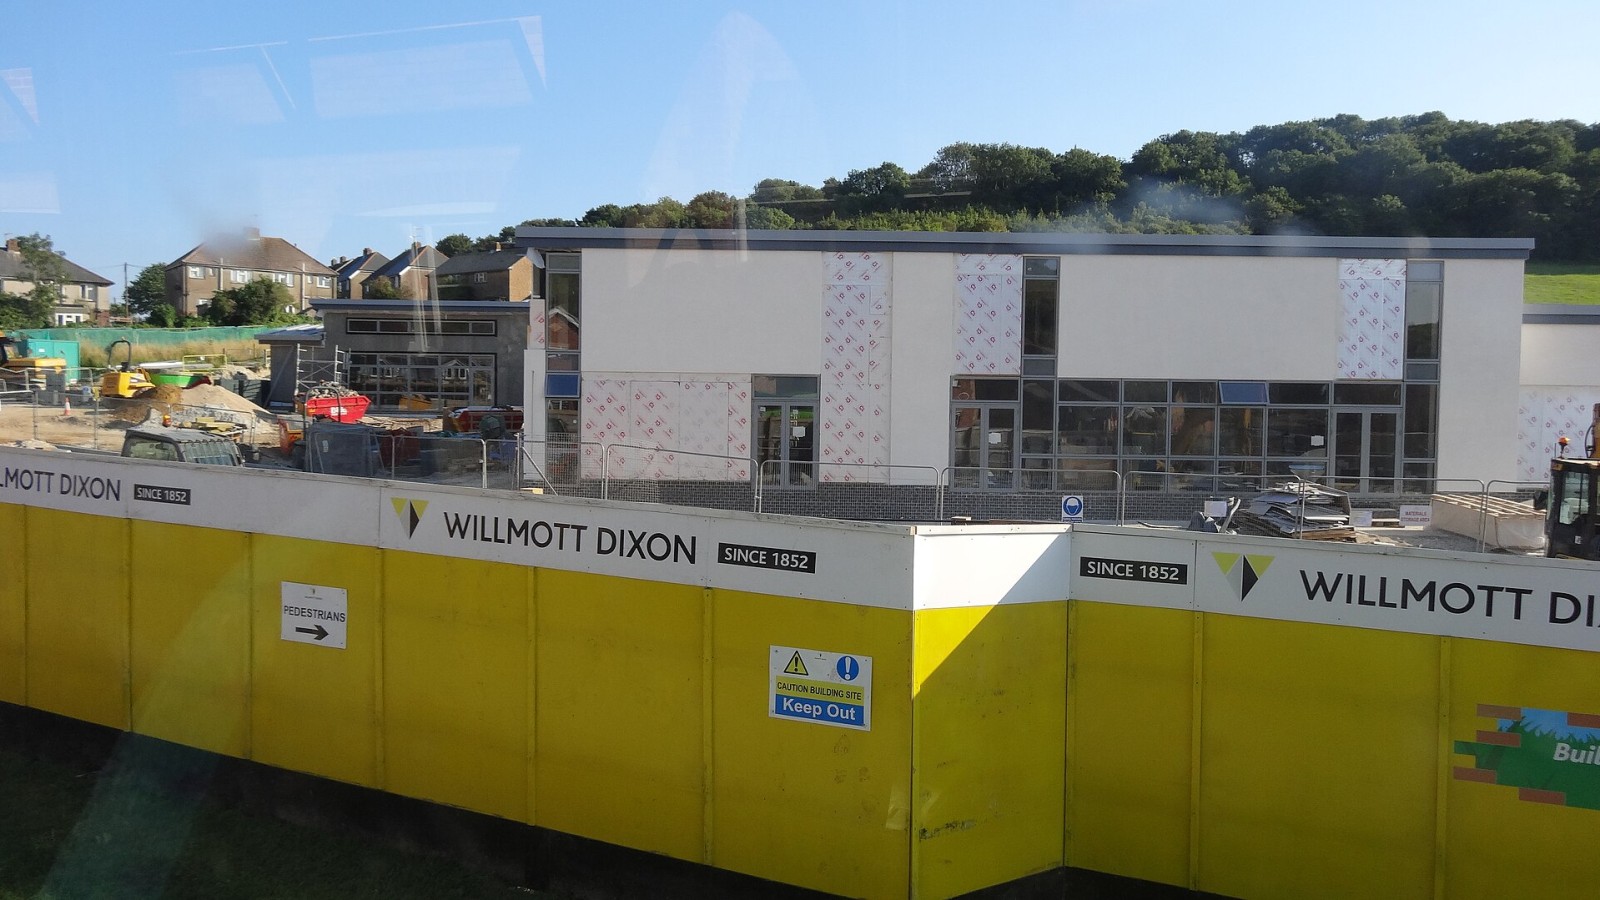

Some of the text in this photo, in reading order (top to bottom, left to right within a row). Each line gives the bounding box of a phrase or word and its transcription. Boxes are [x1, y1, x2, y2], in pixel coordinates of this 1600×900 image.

[0, 467, 121, 501] MOTT DIXON
[136, 487, 187, 502] SINCE 1852
[443, 511, 697, 565] WILLMOTT DIXON
[724, 547, 809, 569] SINCE 1852
[1087, 561, 1180, 581] SINCE 1852
[1299, 569, 1600, 628] WILLMOTT DI
[283, 605, 346, 623] PEDESTRIANS
[777, 681, 862, 701] CAUTION BUILDING SITE
[783, 698, 855, 720] Keep Out
